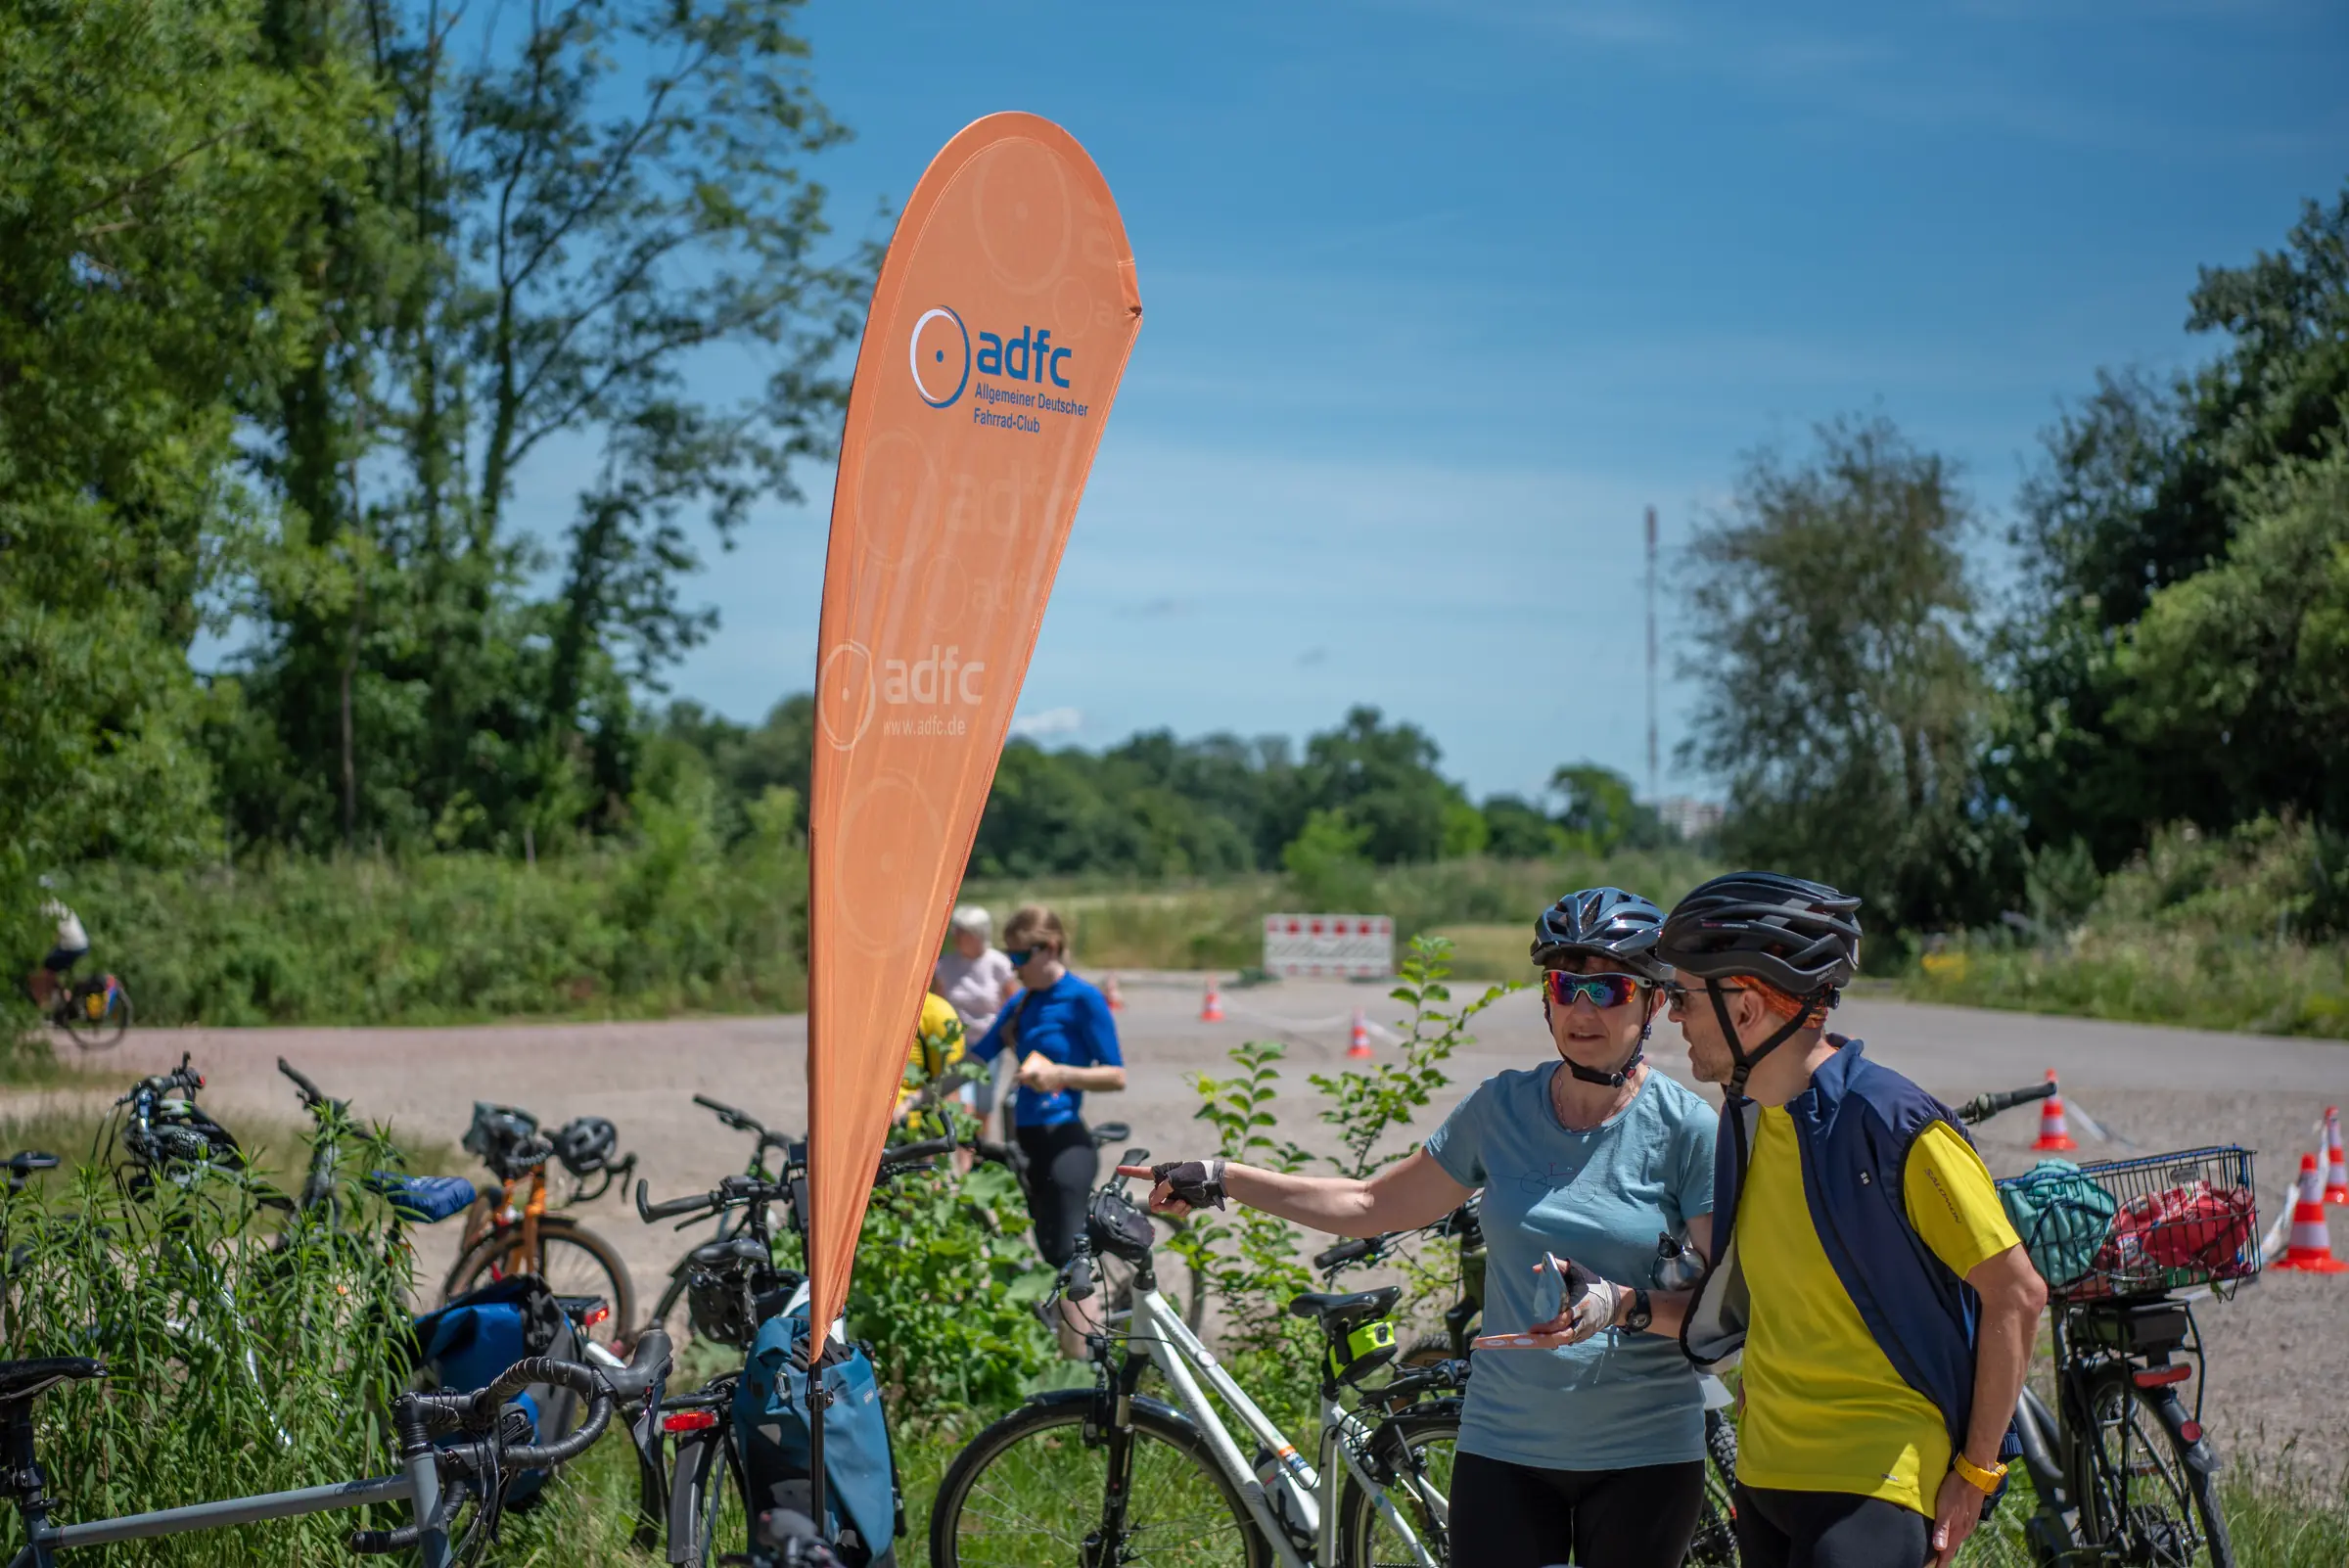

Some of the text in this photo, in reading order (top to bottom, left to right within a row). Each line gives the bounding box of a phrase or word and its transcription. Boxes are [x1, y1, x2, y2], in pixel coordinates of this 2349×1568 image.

[977, 325, 1071, 389] adfc
[974, 407, 1040, 433] Fahrrad-Club
[975, 382, 1088, 417] Allgemeiner Deutscher
[884, 644, 986, 705] adfc
[883, 714, 966, 736] www.adfc.de
[1923, 1167, 1962, 1223] SALOMON
